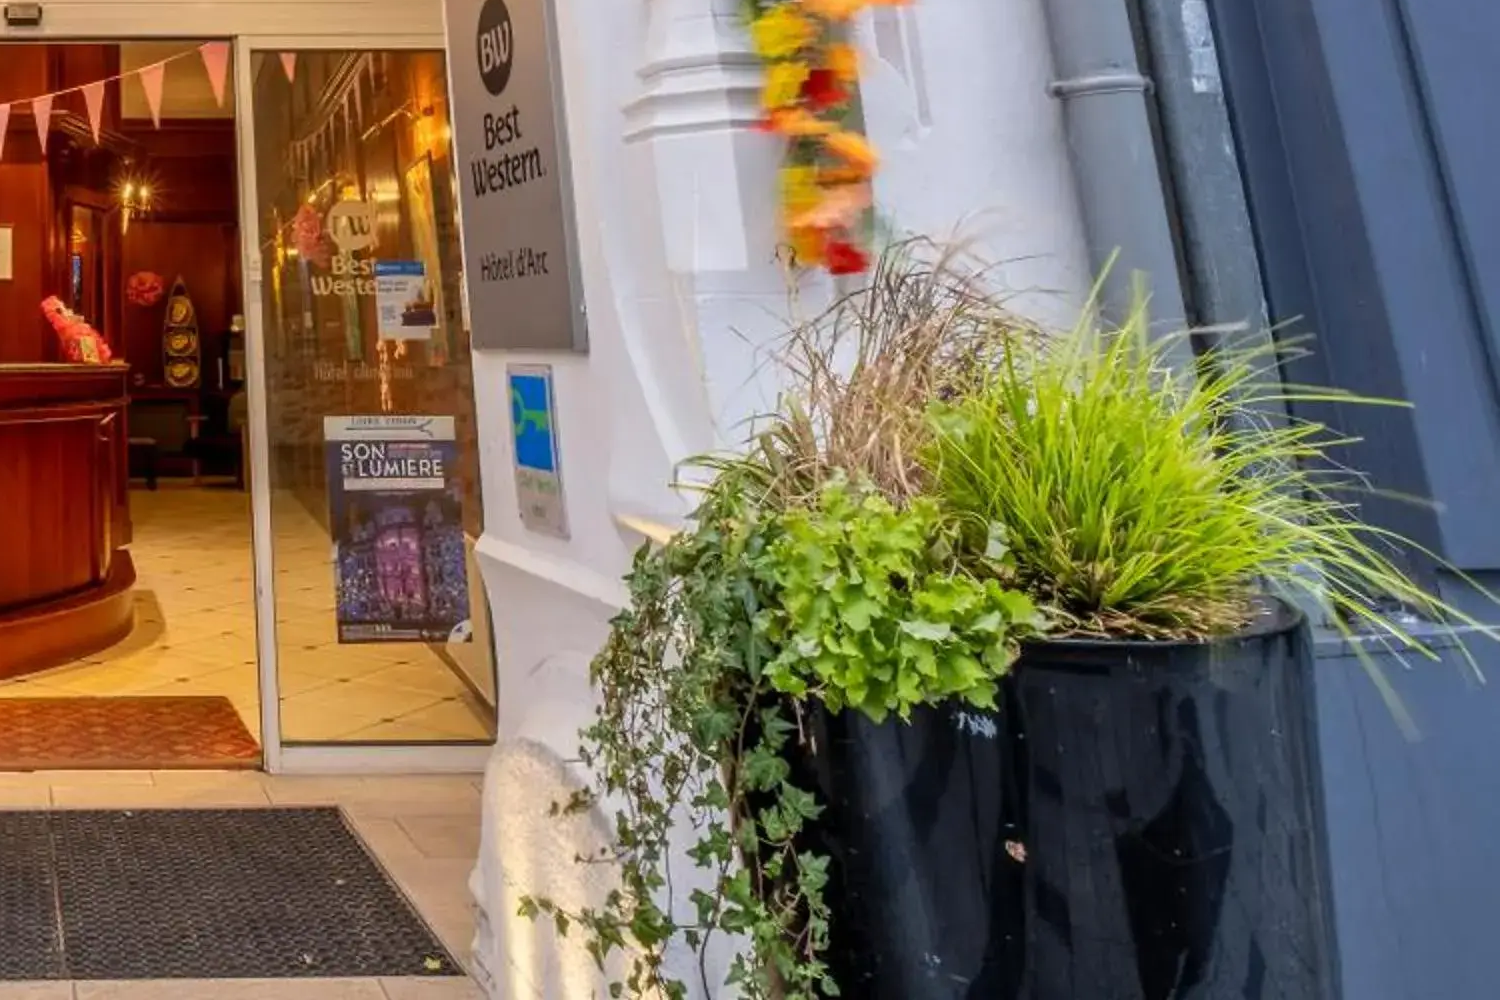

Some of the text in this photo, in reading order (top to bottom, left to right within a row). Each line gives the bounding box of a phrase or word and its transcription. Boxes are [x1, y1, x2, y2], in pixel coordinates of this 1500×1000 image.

[480, 20, 510, 74] BW
[483, 104, 522, 151] Best
[471, 146, 543, 198] Western
[479, 247, 549, 283] Hôtel d'Arc
[311, 276, 377, 296] Weste
[340, 442, 386, 460] SON
